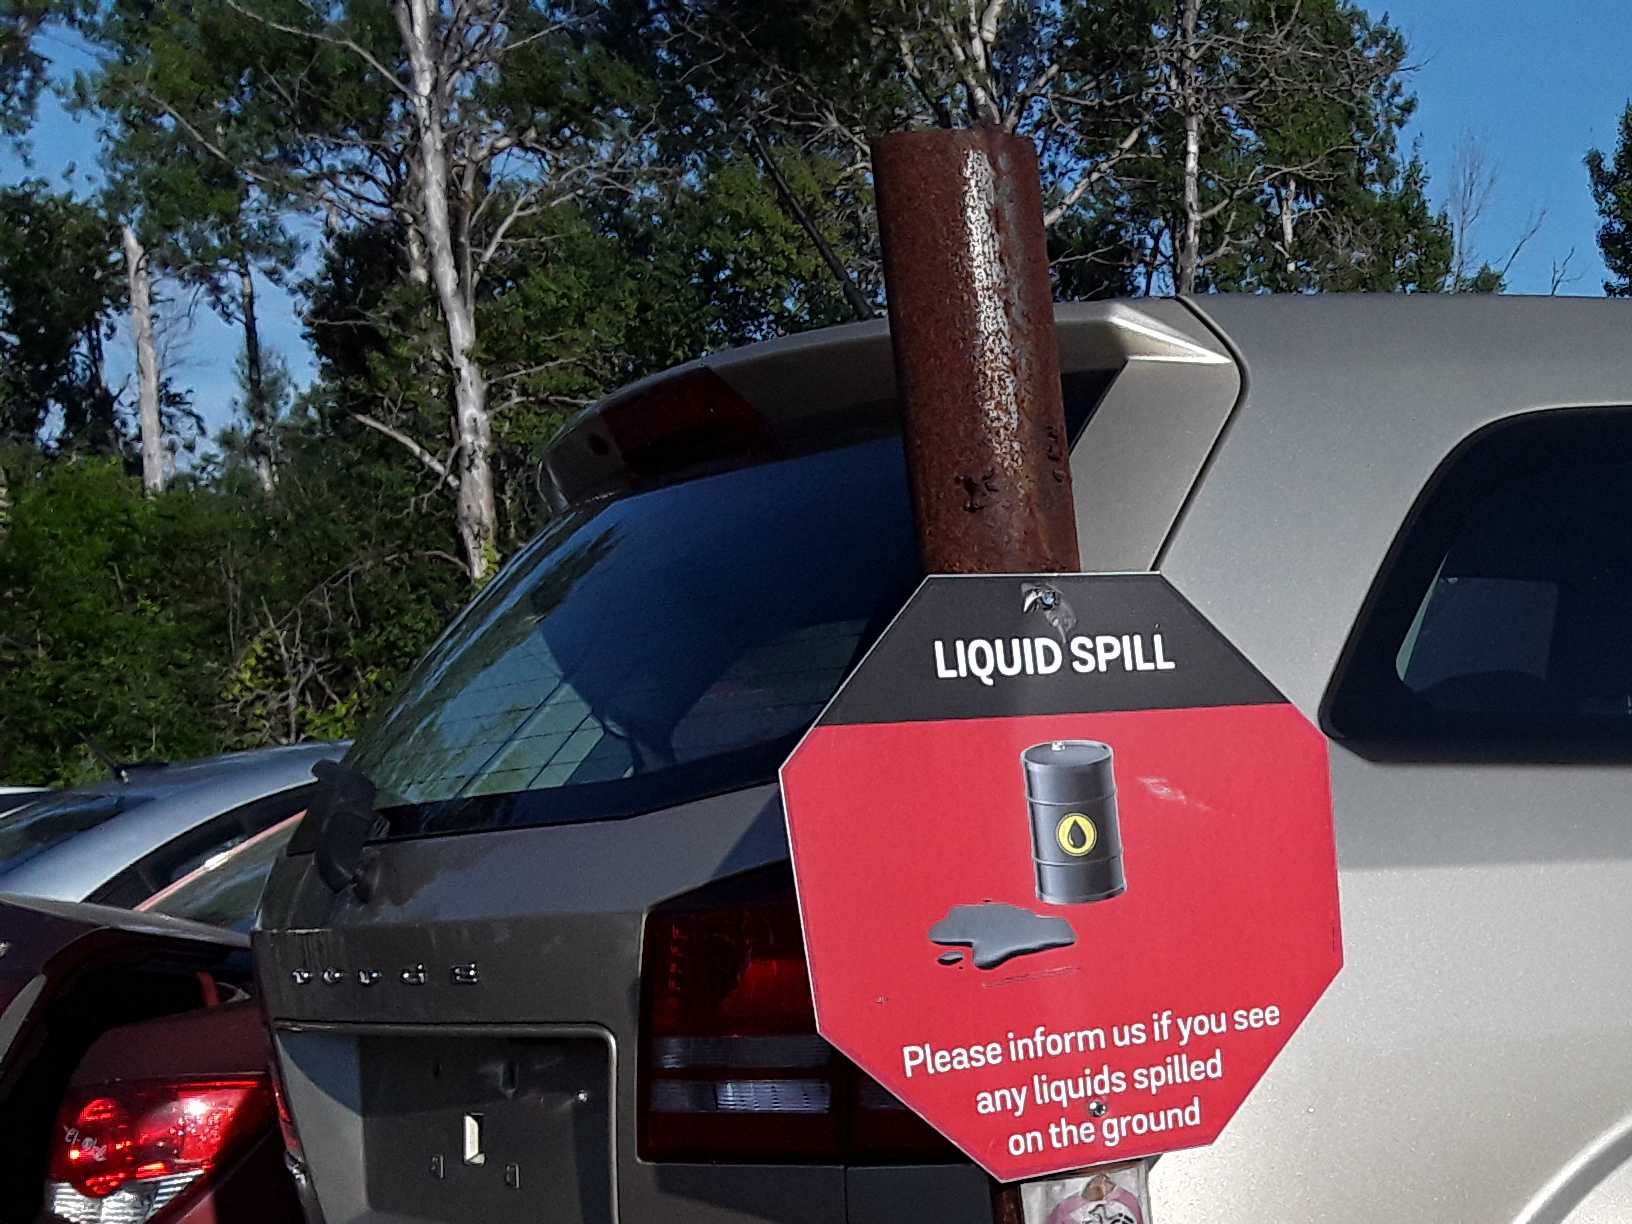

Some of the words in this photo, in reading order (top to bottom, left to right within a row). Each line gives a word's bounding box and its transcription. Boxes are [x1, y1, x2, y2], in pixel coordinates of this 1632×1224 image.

[935, 636, 1065, 686] LIQUID
[1070, 634, 1176, 673] SPILL
[903, 1044, 1003, 1078] Please
[1008, 1027, 1106, 1062] inform
[1113, 1024, 1147, 1047] us
[1153, 1011, 1172, 1042] if
[1176, 1012, 1227, 1046] you
[1234, 1006, 1280, 1031] see
[977, 1086, 1028, 1117] any
[1034, 1067, 1127, 1107] liquids
[1134, 1049, 1223, 1094] spilled
[1009, 1132, 1044, 1156] on
[1049, 1119, 1096, 1149] the
[1103, 1098, 1201, 1146] ground
